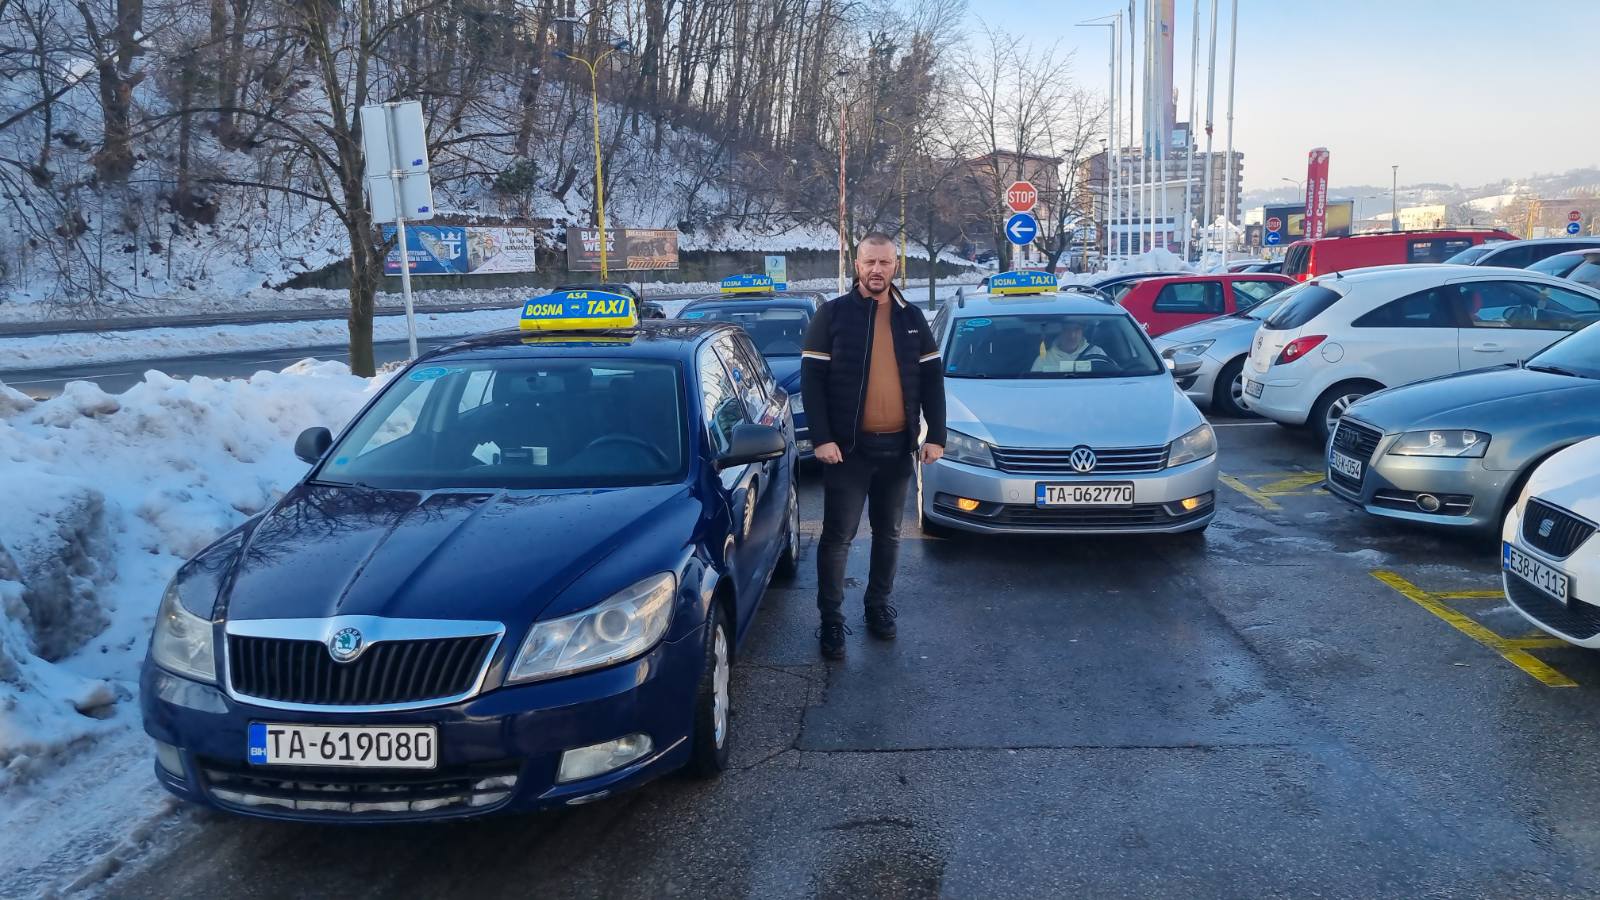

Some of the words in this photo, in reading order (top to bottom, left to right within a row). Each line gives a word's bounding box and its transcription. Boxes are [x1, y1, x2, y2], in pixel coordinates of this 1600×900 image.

[1008, 190, 1035, 204] STOP
[1315, 177, 1326, 217] Centar
[583, 241, 615, 251] WEK
[752, 278, 771, 286] TAXI
[1030, 275, 1054, 285] TAXI
[525, 303, 563, 316] BOSNA
[587, 299, 626, 315] TAXI
[1046, 487, 1132, 503] TA-062770
[1510, 550, 1566, 599] E38-K-113
[250, 748, 267, 756] BIH
[268, 729, 432, 762] TA-619080
